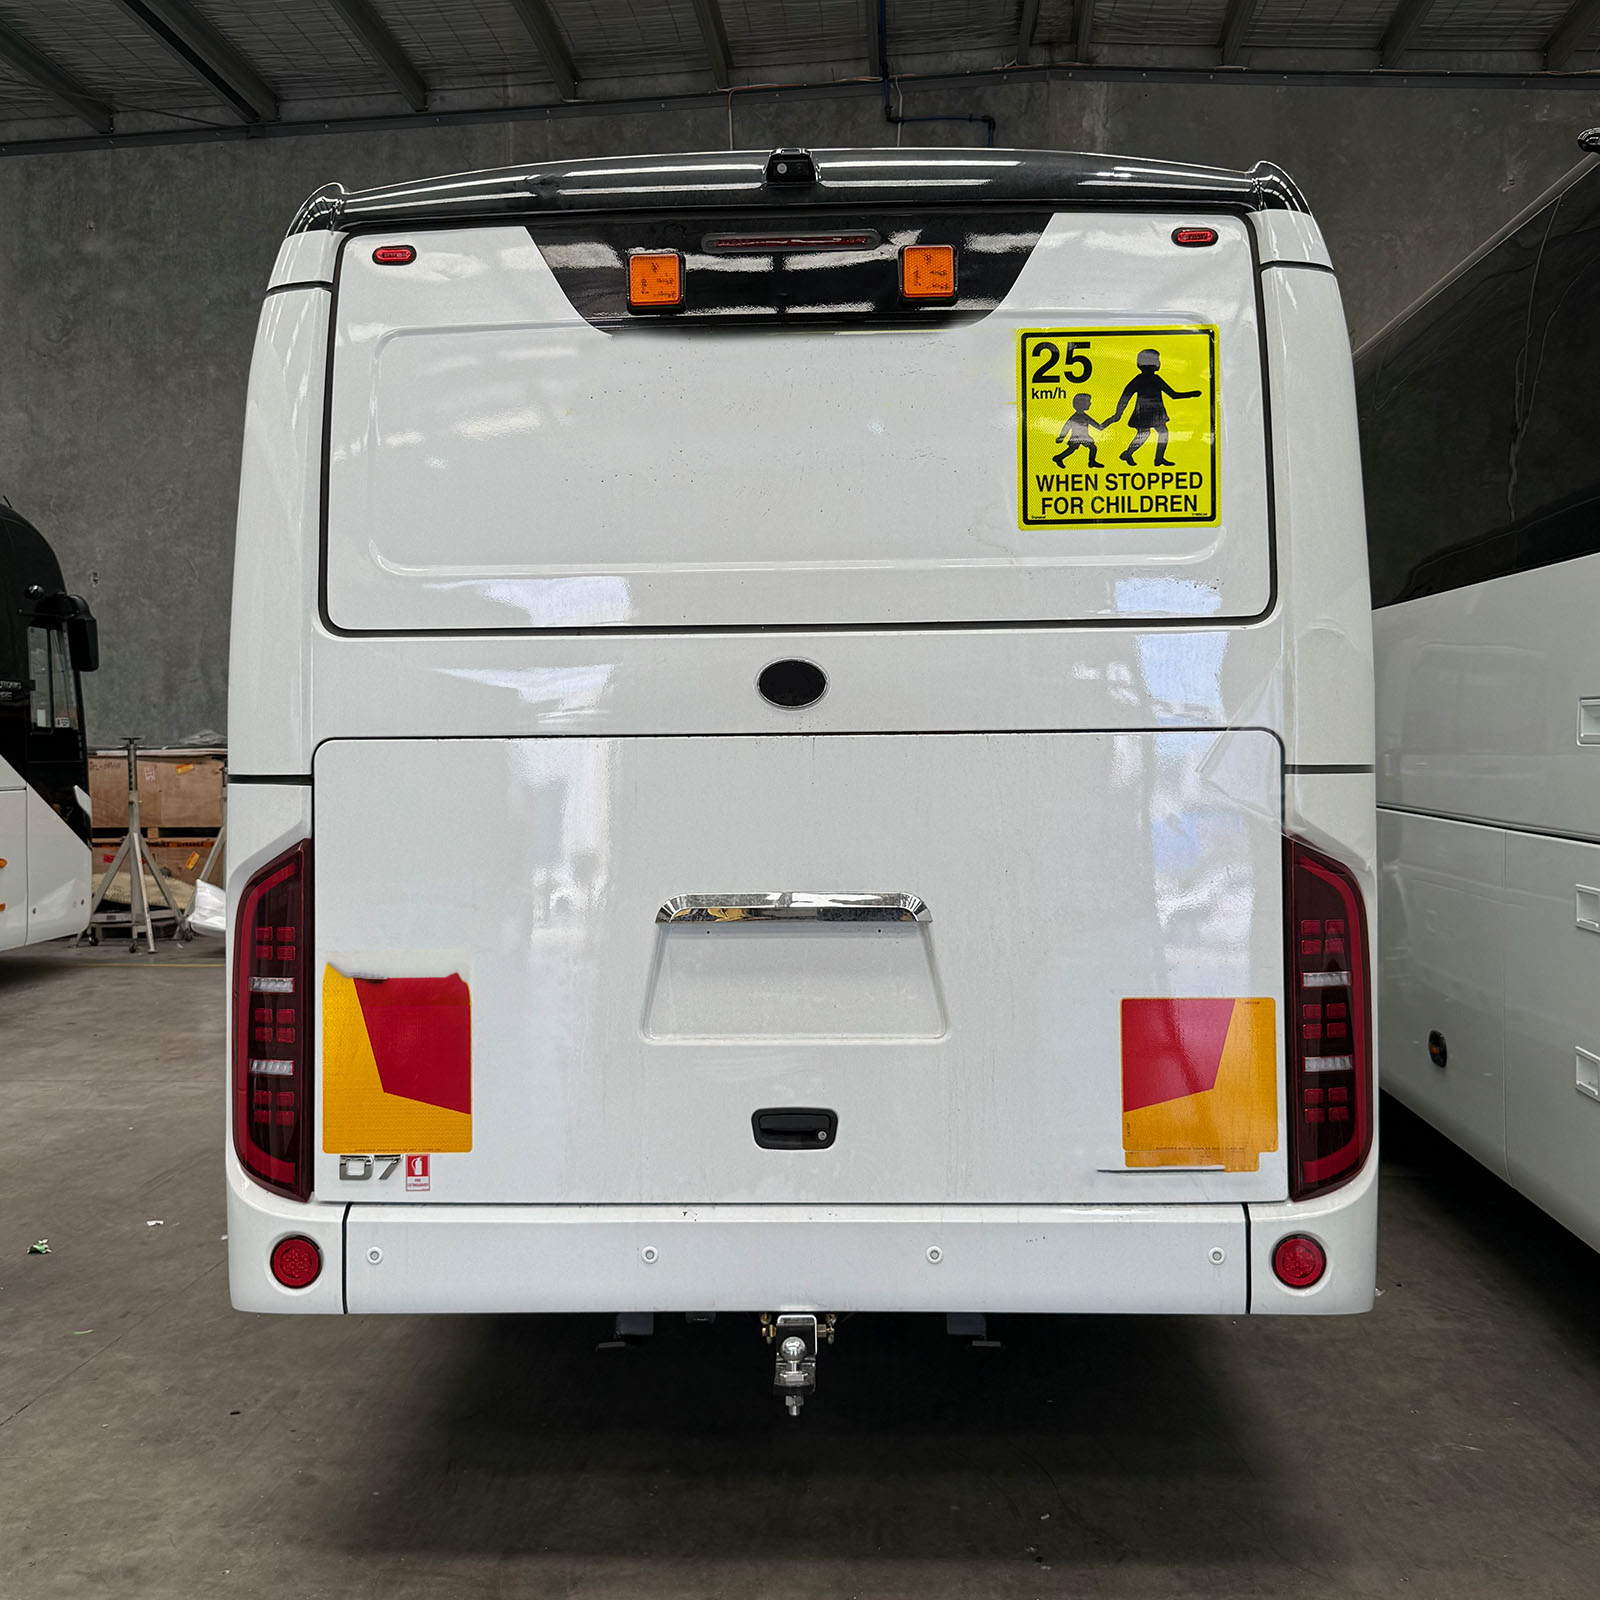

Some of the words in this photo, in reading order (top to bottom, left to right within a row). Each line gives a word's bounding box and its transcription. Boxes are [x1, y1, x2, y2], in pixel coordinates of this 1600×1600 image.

[1031, 341, 1093, 384] 25
[1031, 388, 1067, 400] km/h
[1036, 474, 1098, 492] WHEN
[1105, 472, 1203, 491] STOPPED
[1041, 497, 1084, 515] FOR
[1091, 495, 1198, 514] CHILDREN
